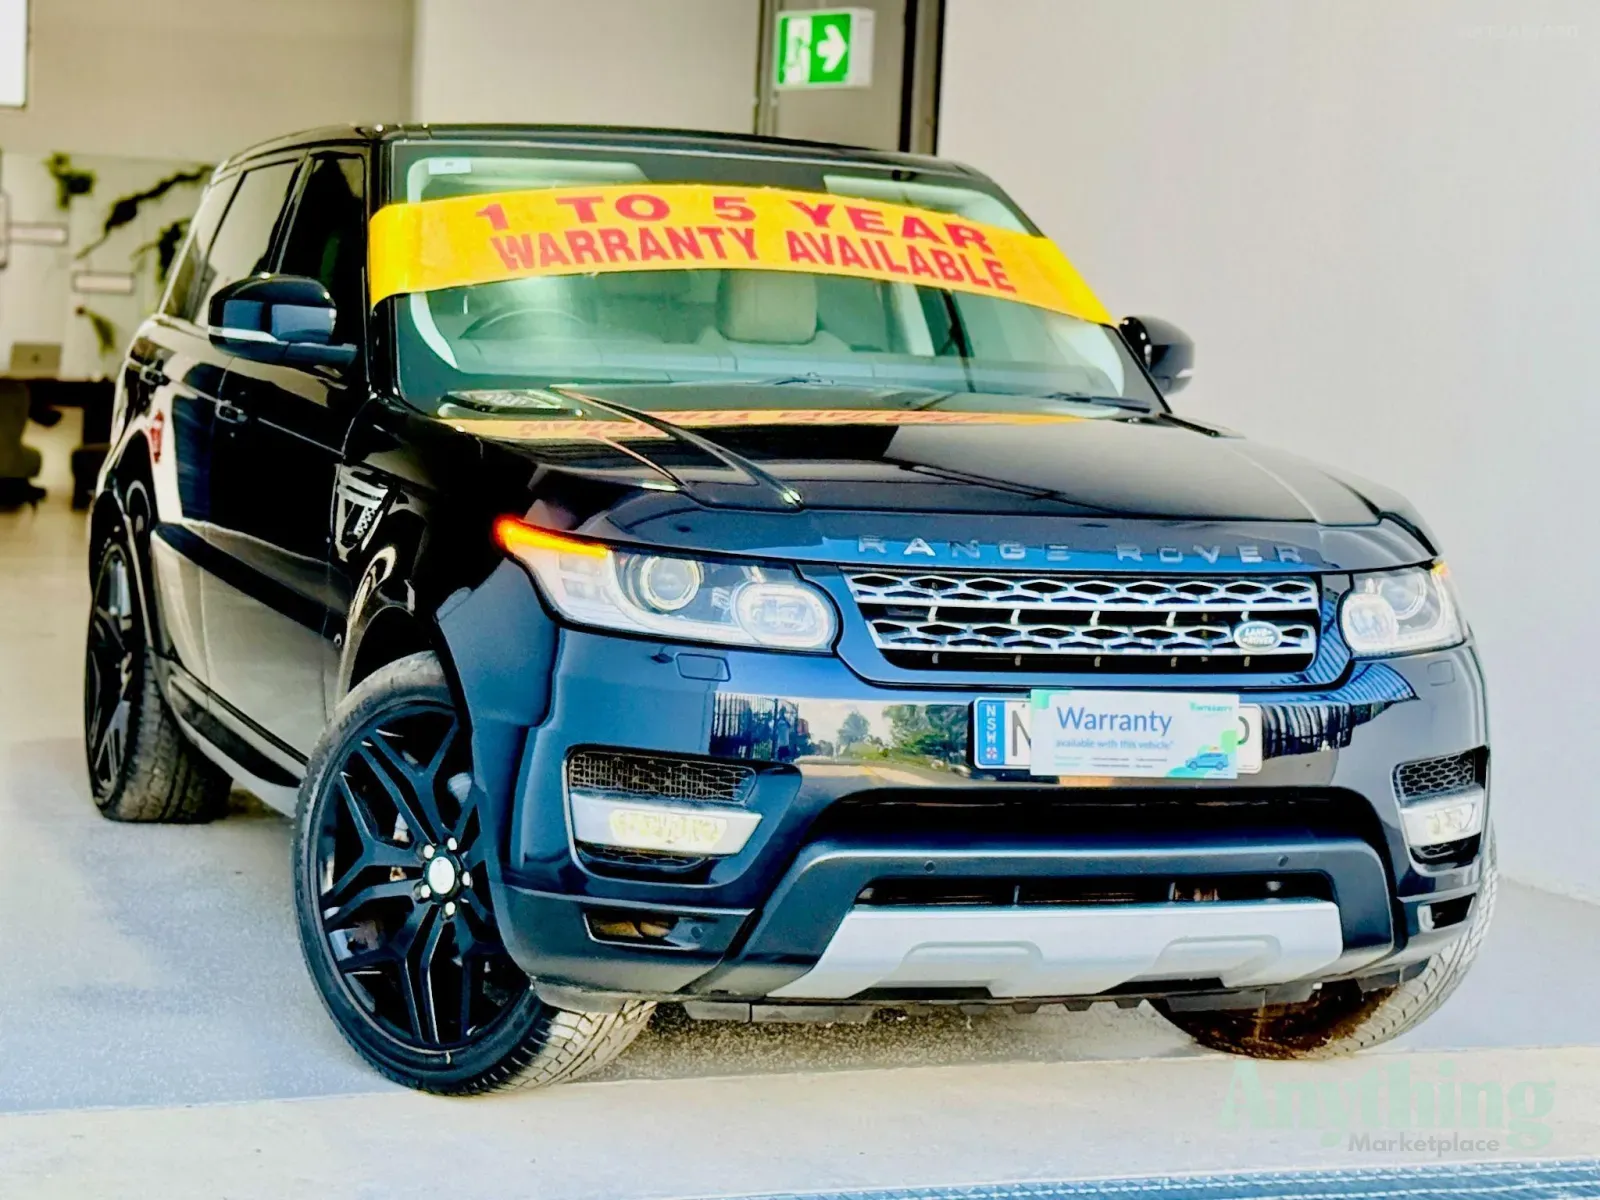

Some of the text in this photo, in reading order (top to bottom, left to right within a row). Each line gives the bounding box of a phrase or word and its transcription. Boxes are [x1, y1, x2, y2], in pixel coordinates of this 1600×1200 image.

[476, 193, 996, 256] 1 TO 5 YEAR
[489, 226, 1017, 293] WARRANTY AVAILABLE
[857, 536, 1304, 564] RANGE ROVER
[985, 705, 997, 743] NSW
[1056, 706, 1173, 736] Warranty
[1055, 738, 1095, 748] available
[1097, 739, 1118, 749] with
[1120, 740, 1137, 749] this
